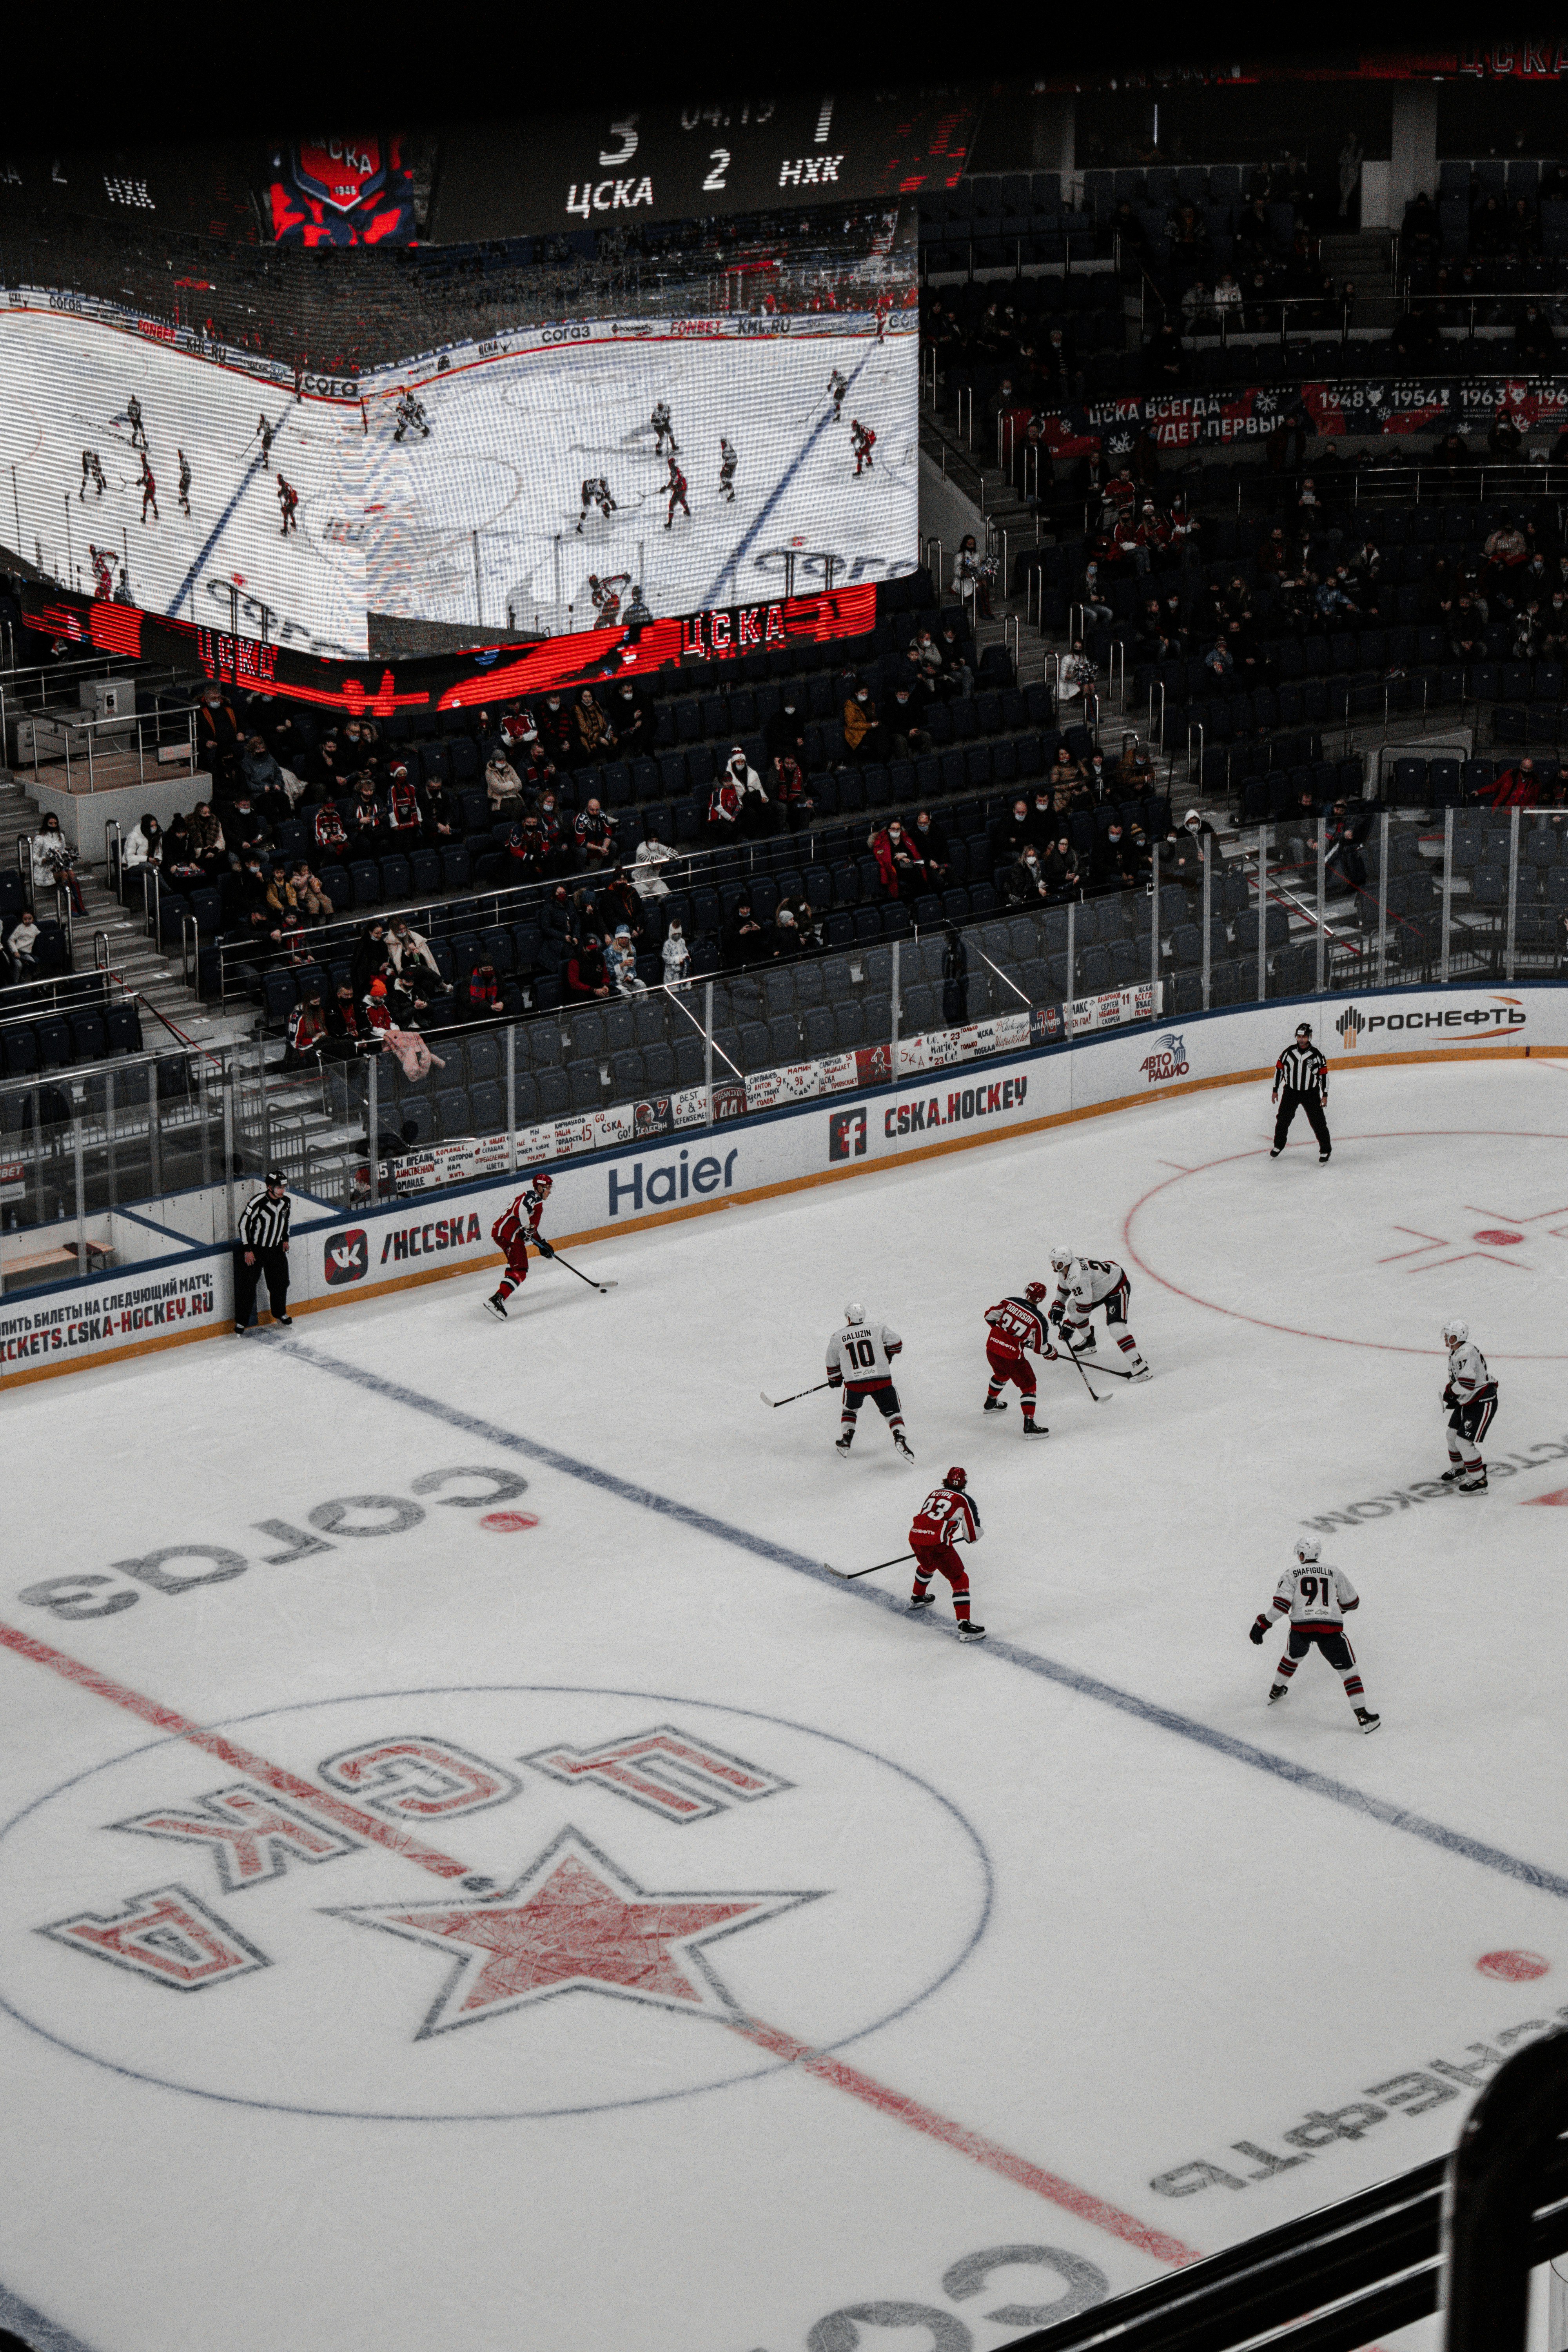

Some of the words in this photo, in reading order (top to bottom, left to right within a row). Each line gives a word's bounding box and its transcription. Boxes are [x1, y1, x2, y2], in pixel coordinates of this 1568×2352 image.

[566, 176, 653, 219] ЦСКА
[702, 148, 731, 191] 2
[779, 155, 845, 187] НХК
[671, 320, 722, 334] FONBET
[542, 325, 591, 343] согаз
[1319, 391, 1364, 408] 1948
[1392, 389, 1438, 406] 1954
[1460, 389, 1506, 406] 1963
[1089, 403, 1139, 426] ЦСКА
[1145, 397, 1220, 419] ВСЕГДА
[684, 604, 785, 657] ЦСКА
[107, 695, 114, 707] 6
[1098, 992, 1121, 1003] АНДРОНОВ
[1122, 993, 1130, 1005] 11
[1134, 992, 1152, 1002] ВСЕГД
[1101, 1000, 1119, 1010] СЕРГЕЙ
[1368, 1009, 1526, 1033] РОСНЕФТЬ
[961, 1025, 978, 1034] ТОЛЬКО
[961, 1041, 977, 1051] ТОЛЬКО
[974, 1044, 996, 1055] ПОБЕДА
[820, 1057, 842, 1069] САМОРУКОВ
[935, 1056, 944, 1065] 23
[1139, 1052, 1172, 1072] АВТО
[788, 1065, 811, 1074] МАМИН
[824, 1063, 850, 1075] ЗАЩИЩАЕТ
[1149, 1062, 1189, 1083] РАДИО
[754, 1082, 771, 1091] АНТОН
[795, 1076, 803, 1085] 98
[820, 1075, 835, 1085] ЦСКА
[831, 1078, 857, 1089] ПРОПУСКАЕТ
[679, 1091, 699, 1103] BEST
[757, 1094, 776, 1107] ГОЛОВ!
[657, 1099, 668, 1116] 7
[676, 1104, 682, 1114] 6
[688, 1102, 695, 1112] &
[720, 1099, 738, 1118] 44
[885, 1076, 1027, 1138] CSKA.HOCKEY
[555, 1118, 585, 1129] КАРНАУХОВ
[581, 1124, 592, 1142] 15
[617, 1125, 631, 1140] GO!
[489, 1136, 506, 1145] НАШИХ
[448, 1150, 473, 1162] КОТОРОЙ
[527, 1153, 546, 1161] РУКАМИ
[486, 1161, 504, 1171] ЦВЕТА
[609, 1148, 738, 1216] Haier
[380, 1212, 481, 1264] /HCCSKA
[1072, 1287, 1083, 1296] 22
[34, 1304, 82, 1328] БИЛЕТЫ
[85, 1299, 101, 1316] НА
[103, 1277, 178, 1312] СЛЕДУЮЩИЙ
[179, 1273, 214, 1293] МАТЧ:
[1006, 1303, 1034, 1325] ROBINSON
[1001, 1313, 1029, 1338] 37
[842, 1329, 871, 1342] GALUZIN
[845, 1339, 875, 1370] 10
[1458, 1359, 1467, 1370] 37
[17, 1465, 530, 1621] согаз
[1292, 1567, 1333, 1578] SHAFIGULLIN
[1300, 1577, 1329, 1607] 91
